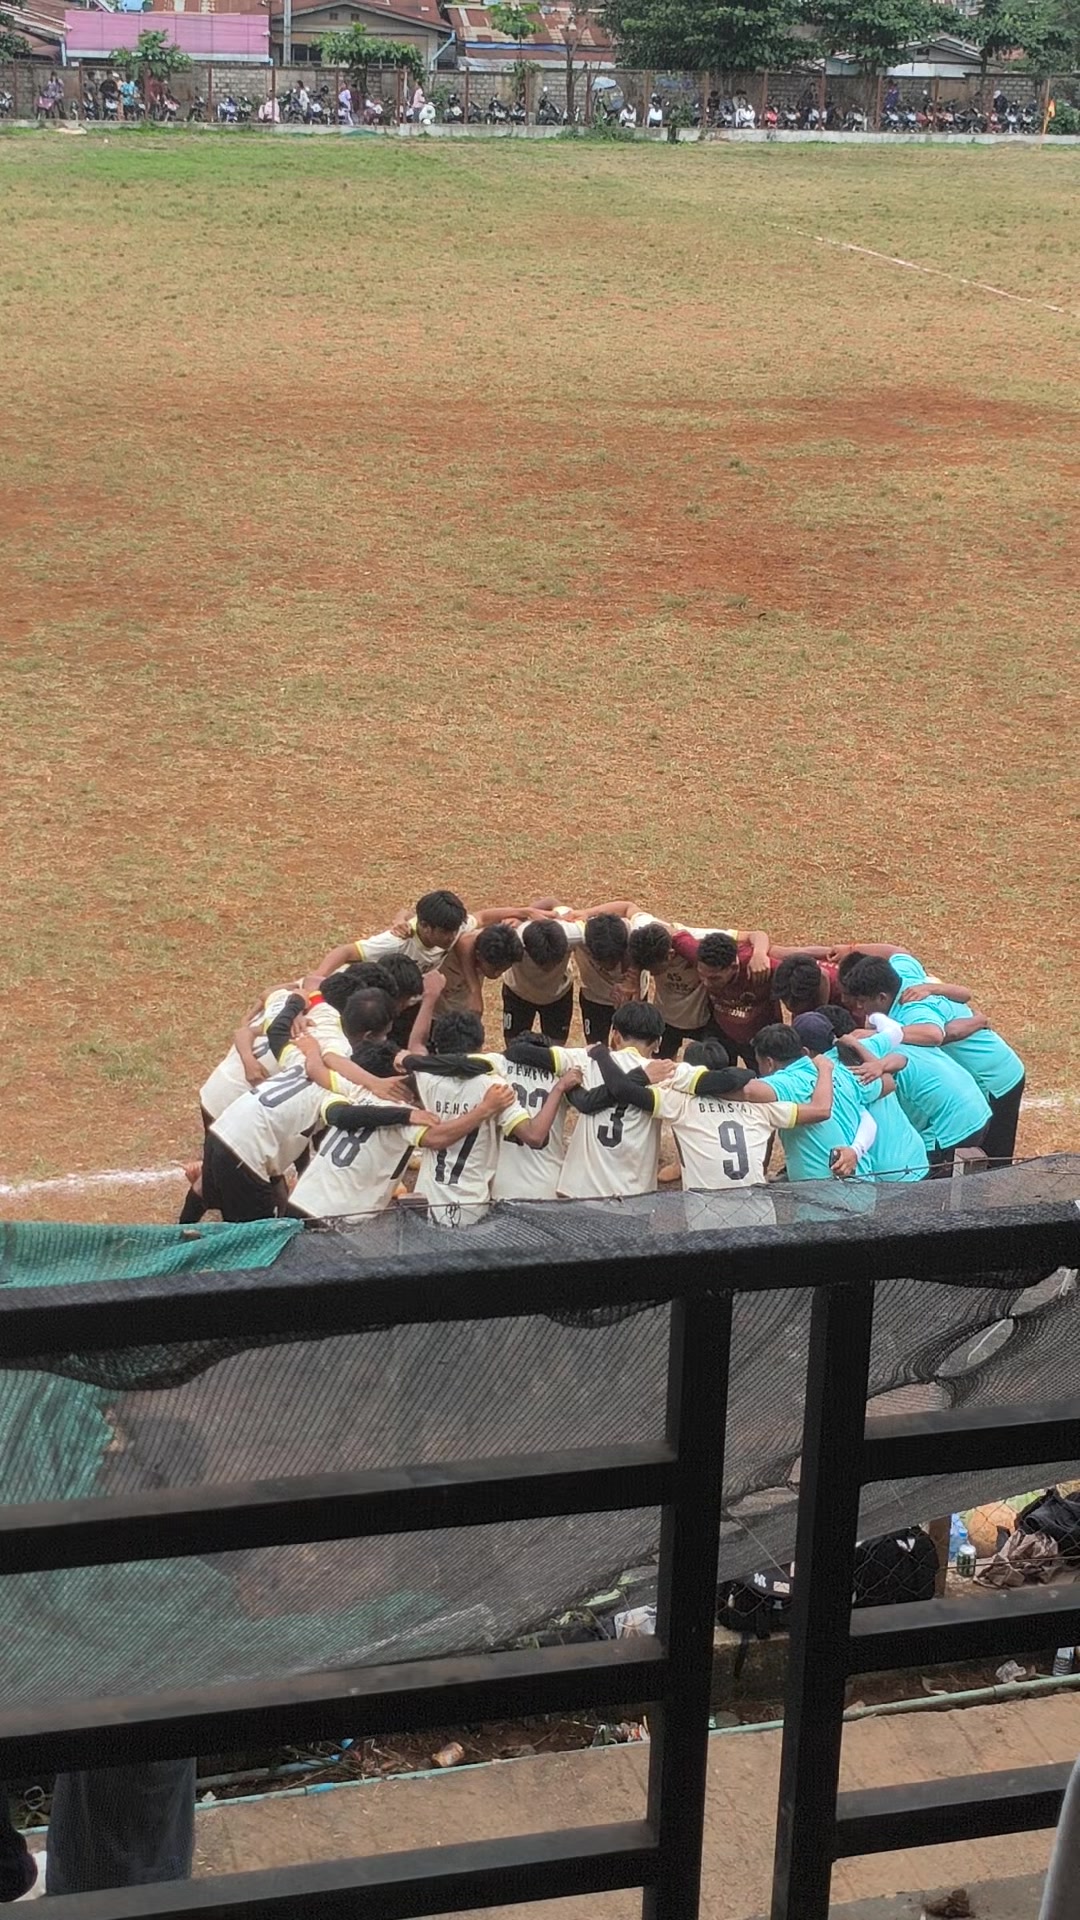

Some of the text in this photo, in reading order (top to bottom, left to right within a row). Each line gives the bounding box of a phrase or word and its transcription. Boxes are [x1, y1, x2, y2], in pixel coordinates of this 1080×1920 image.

[319, 1126, 375, 1168] 18
[597, 1107, 627, 1148] 3
[717, 1120, 750, 1181] 9
